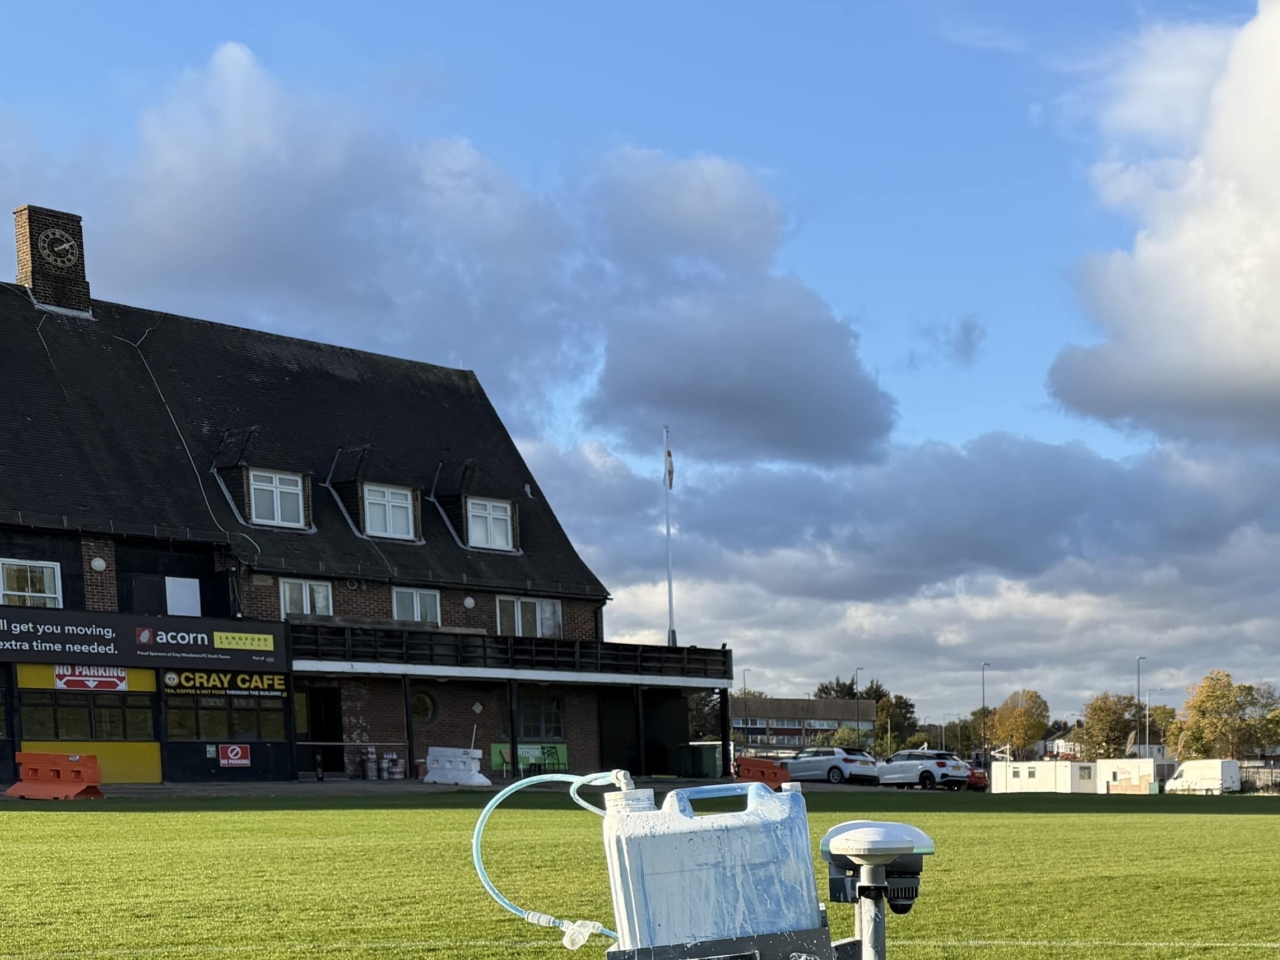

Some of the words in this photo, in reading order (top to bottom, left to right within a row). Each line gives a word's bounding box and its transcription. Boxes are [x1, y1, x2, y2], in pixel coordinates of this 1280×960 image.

[11, 622, 34, 635] get
[37, 624, 61, 635] you
[65, 624, 116, 639] moving,
[156, 631, 208, 645] acorn
[32, 640, 62, 652] time
[66, 642, 118, 654] needed.
[55, 664, 72, 675] NO
[75, 665, 126, 677] PARKING
[180, 672, 232, 688] CRAY
[236, 674, 286, 690] CAFE
